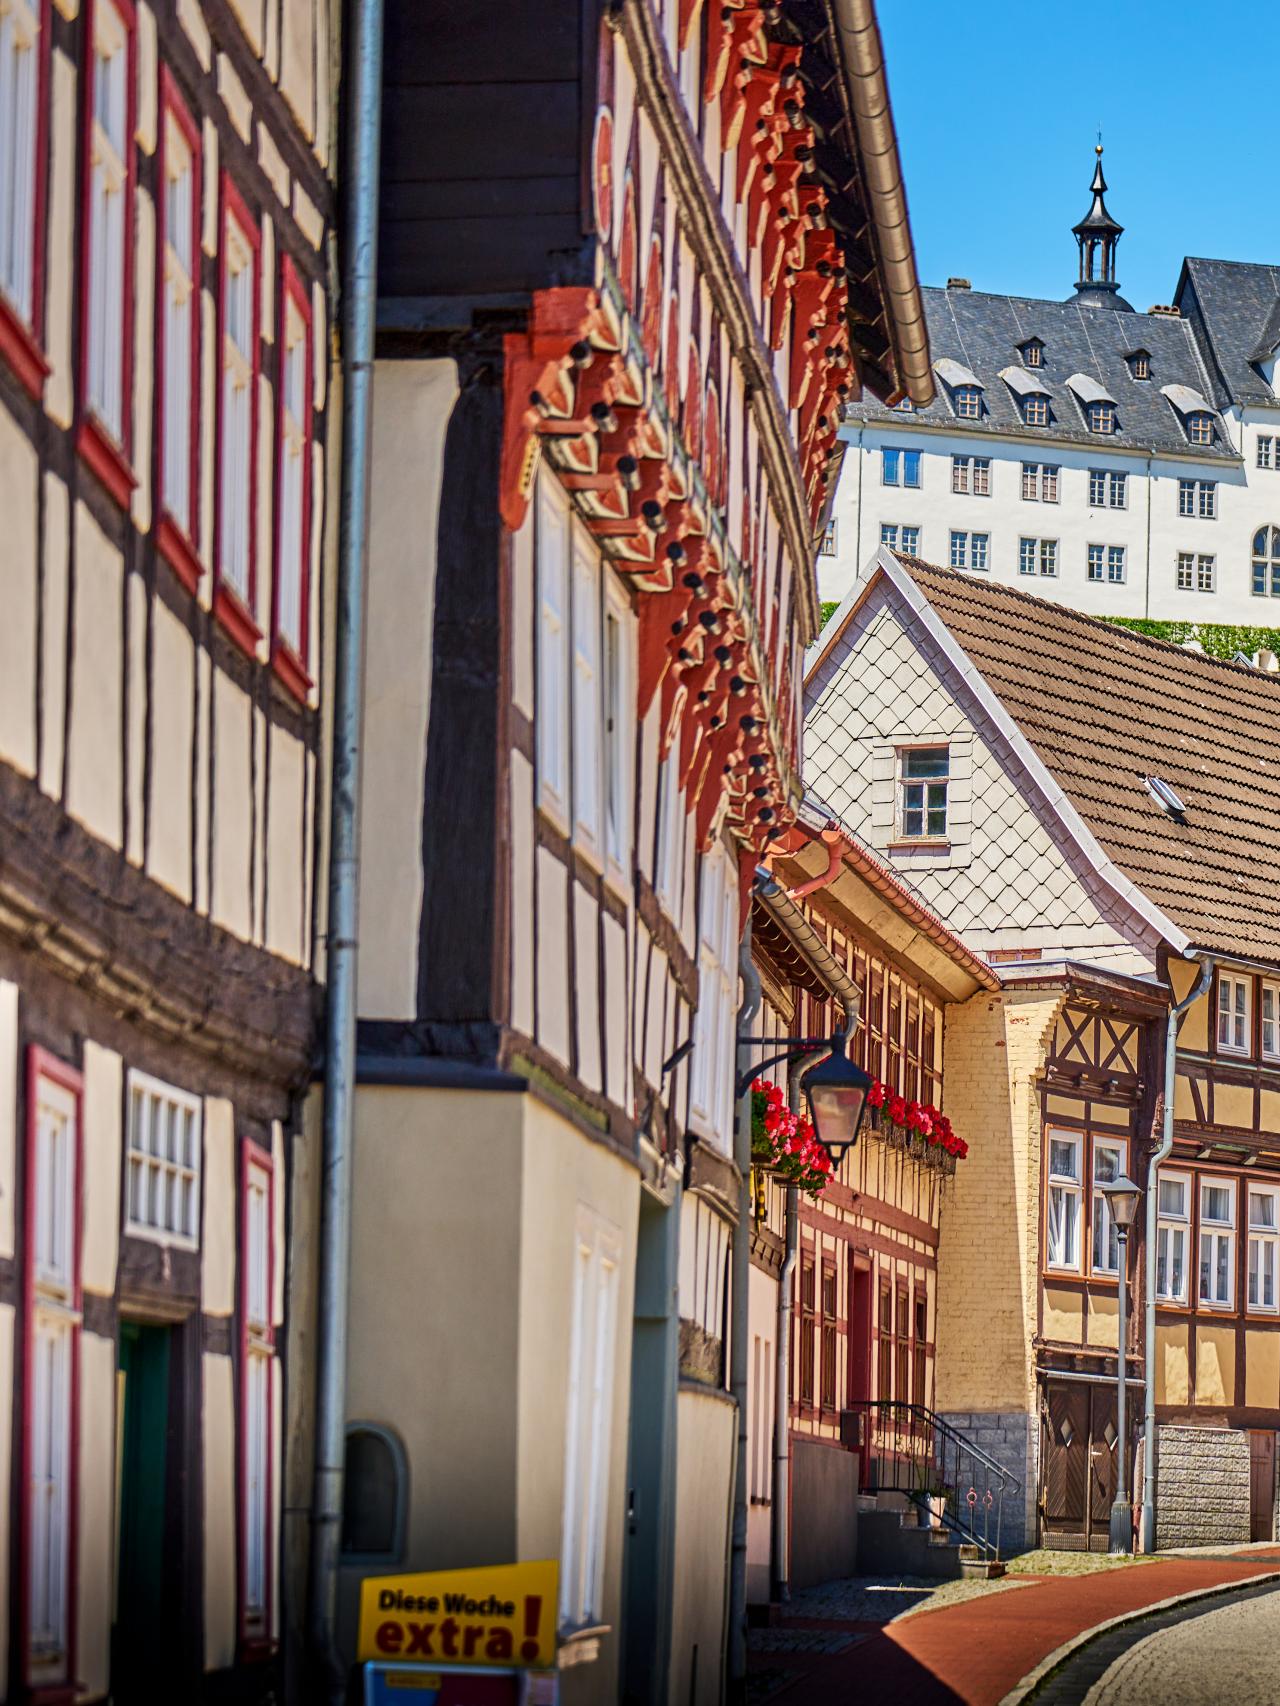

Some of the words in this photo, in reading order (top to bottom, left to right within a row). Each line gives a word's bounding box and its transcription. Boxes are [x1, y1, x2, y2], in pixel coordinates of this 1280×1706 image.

[379, 1589, 439, 1612] Diese
[443, 1592, 515, 1617] Woche
[376, 1595, 542, 1661] extra!
